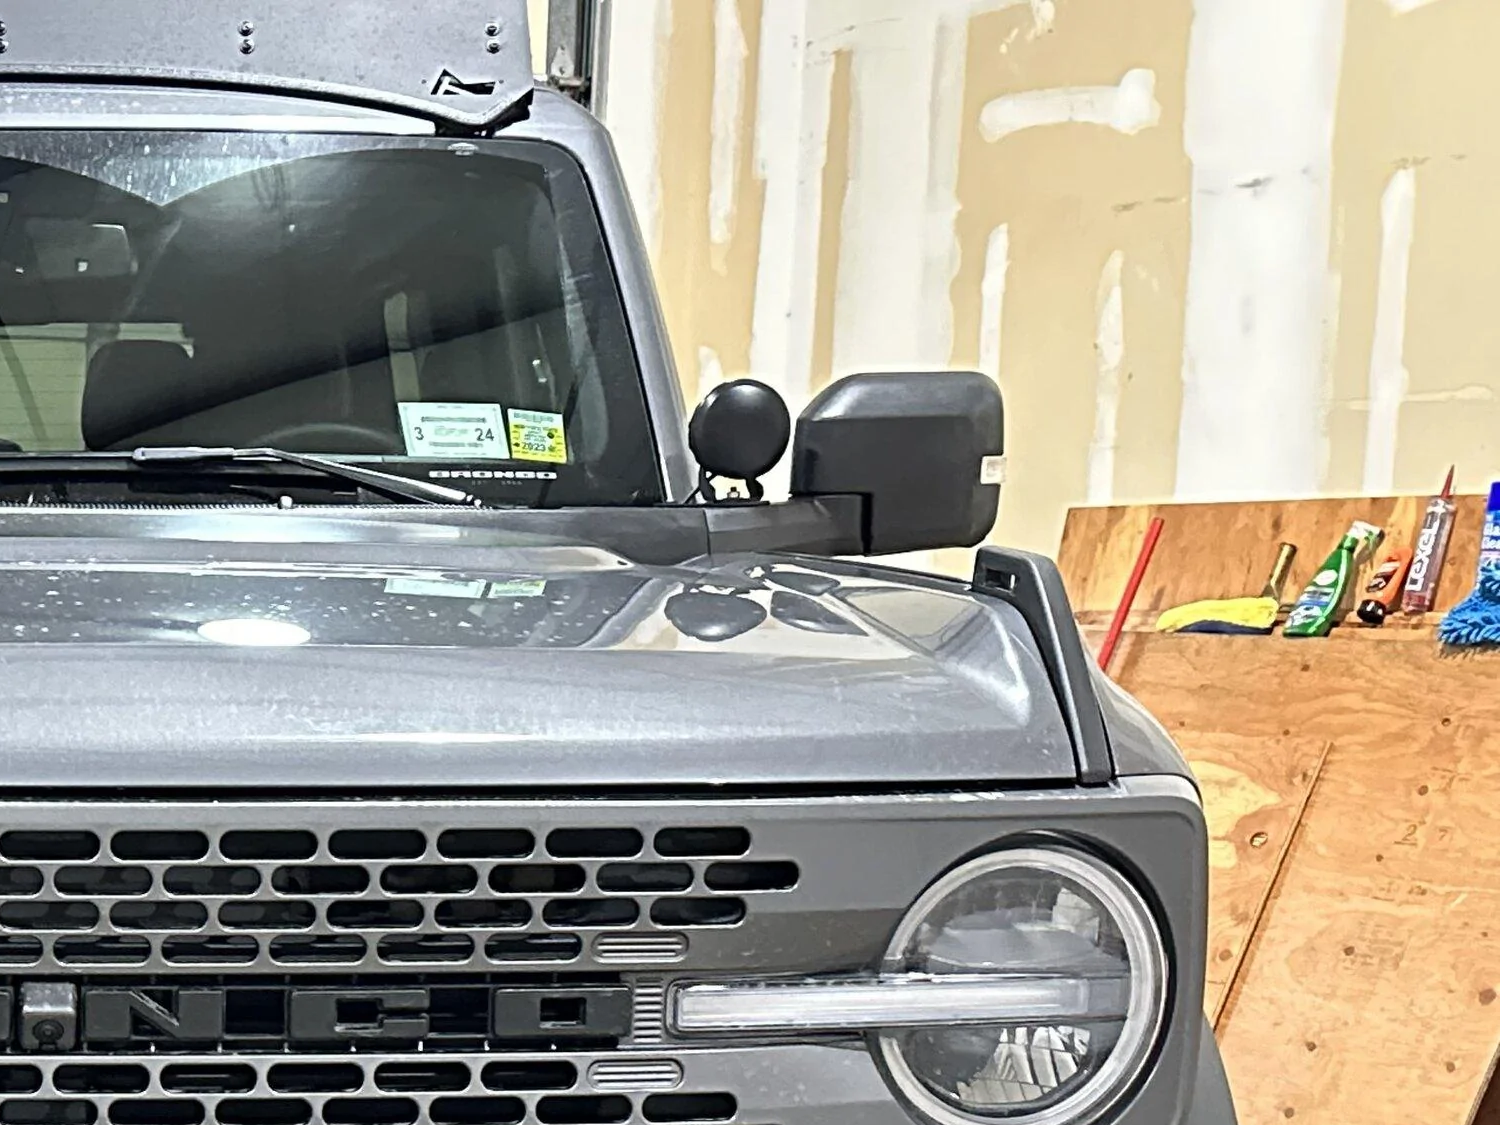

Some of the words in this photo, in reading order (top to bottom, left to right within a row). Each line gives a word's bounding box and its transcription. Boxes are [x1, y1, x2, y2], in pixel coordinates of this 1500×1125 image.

[414, 426, 424, 441] 3
[474, 427, 495, 442] 24
[428, 470, 557, 479] BRONCO
